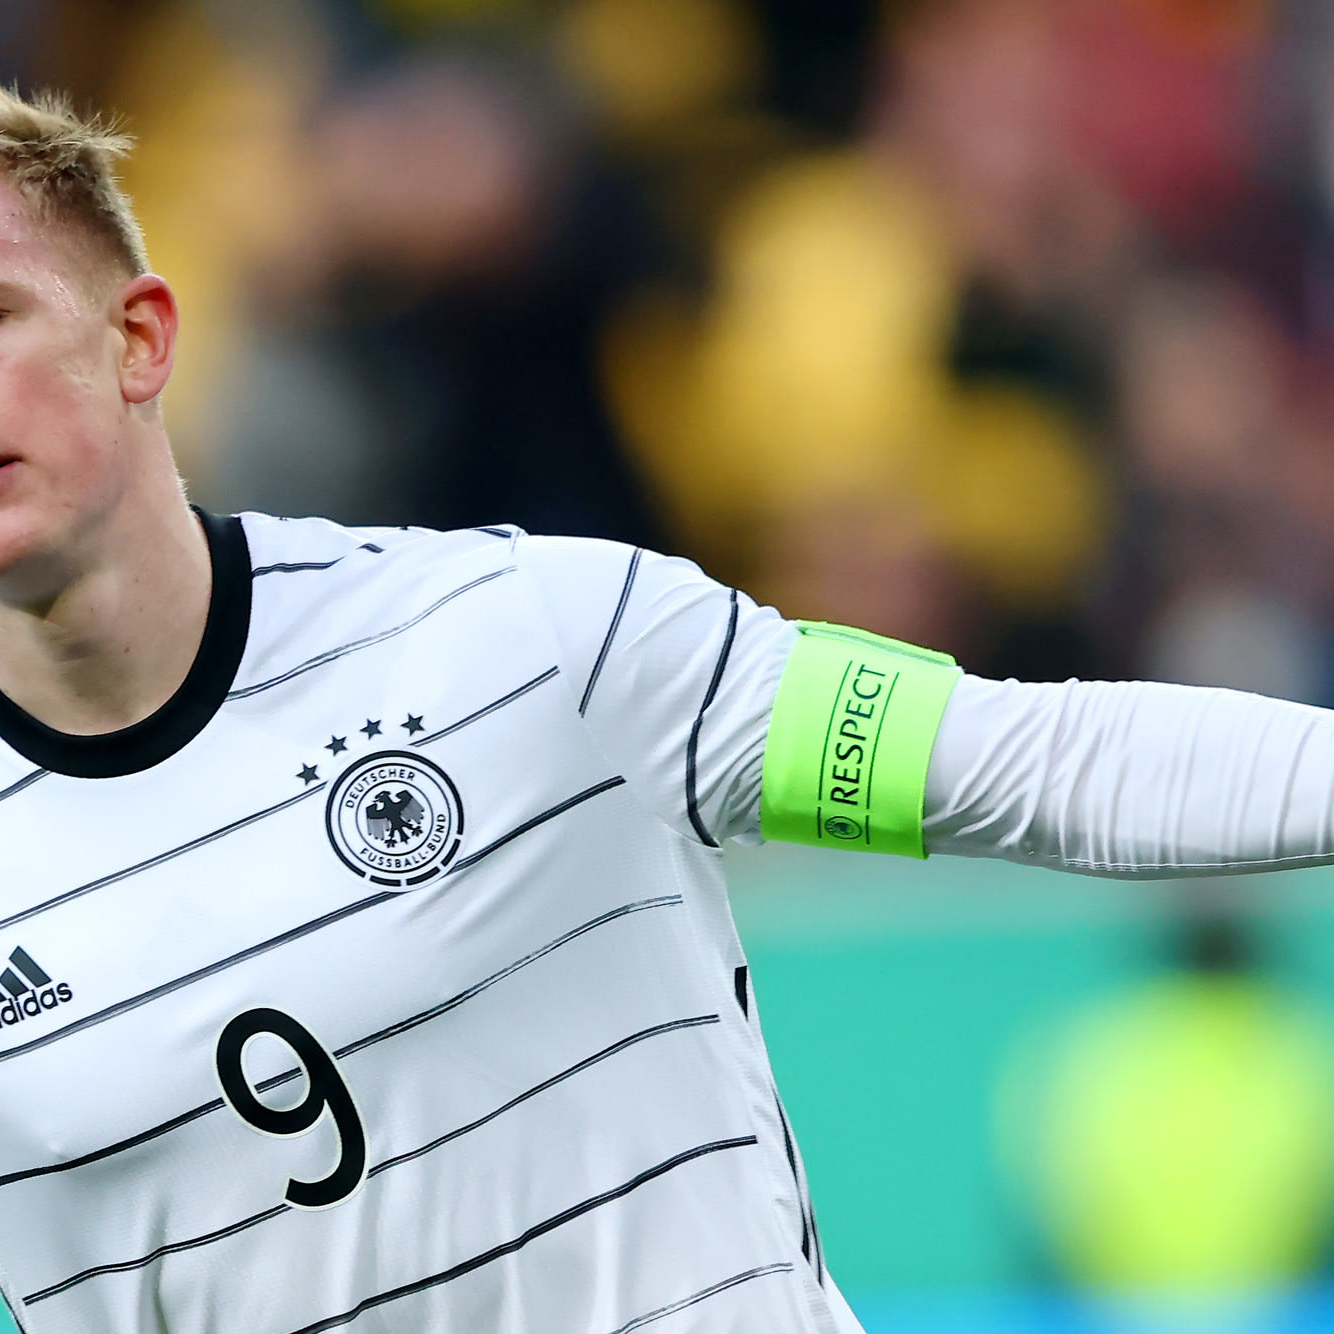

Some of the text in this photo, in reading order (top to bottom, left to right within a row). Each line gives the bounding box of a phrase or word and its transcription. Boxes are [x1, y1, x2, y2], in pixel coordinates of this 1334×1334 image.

[830, 664, 886, 806] RESPECT
[345, 768, 416, 809] DEUTSCHER
[359, 813, 447, 869] FUSSBALL-BUND
[215, 1006, 367, 1209] 9
